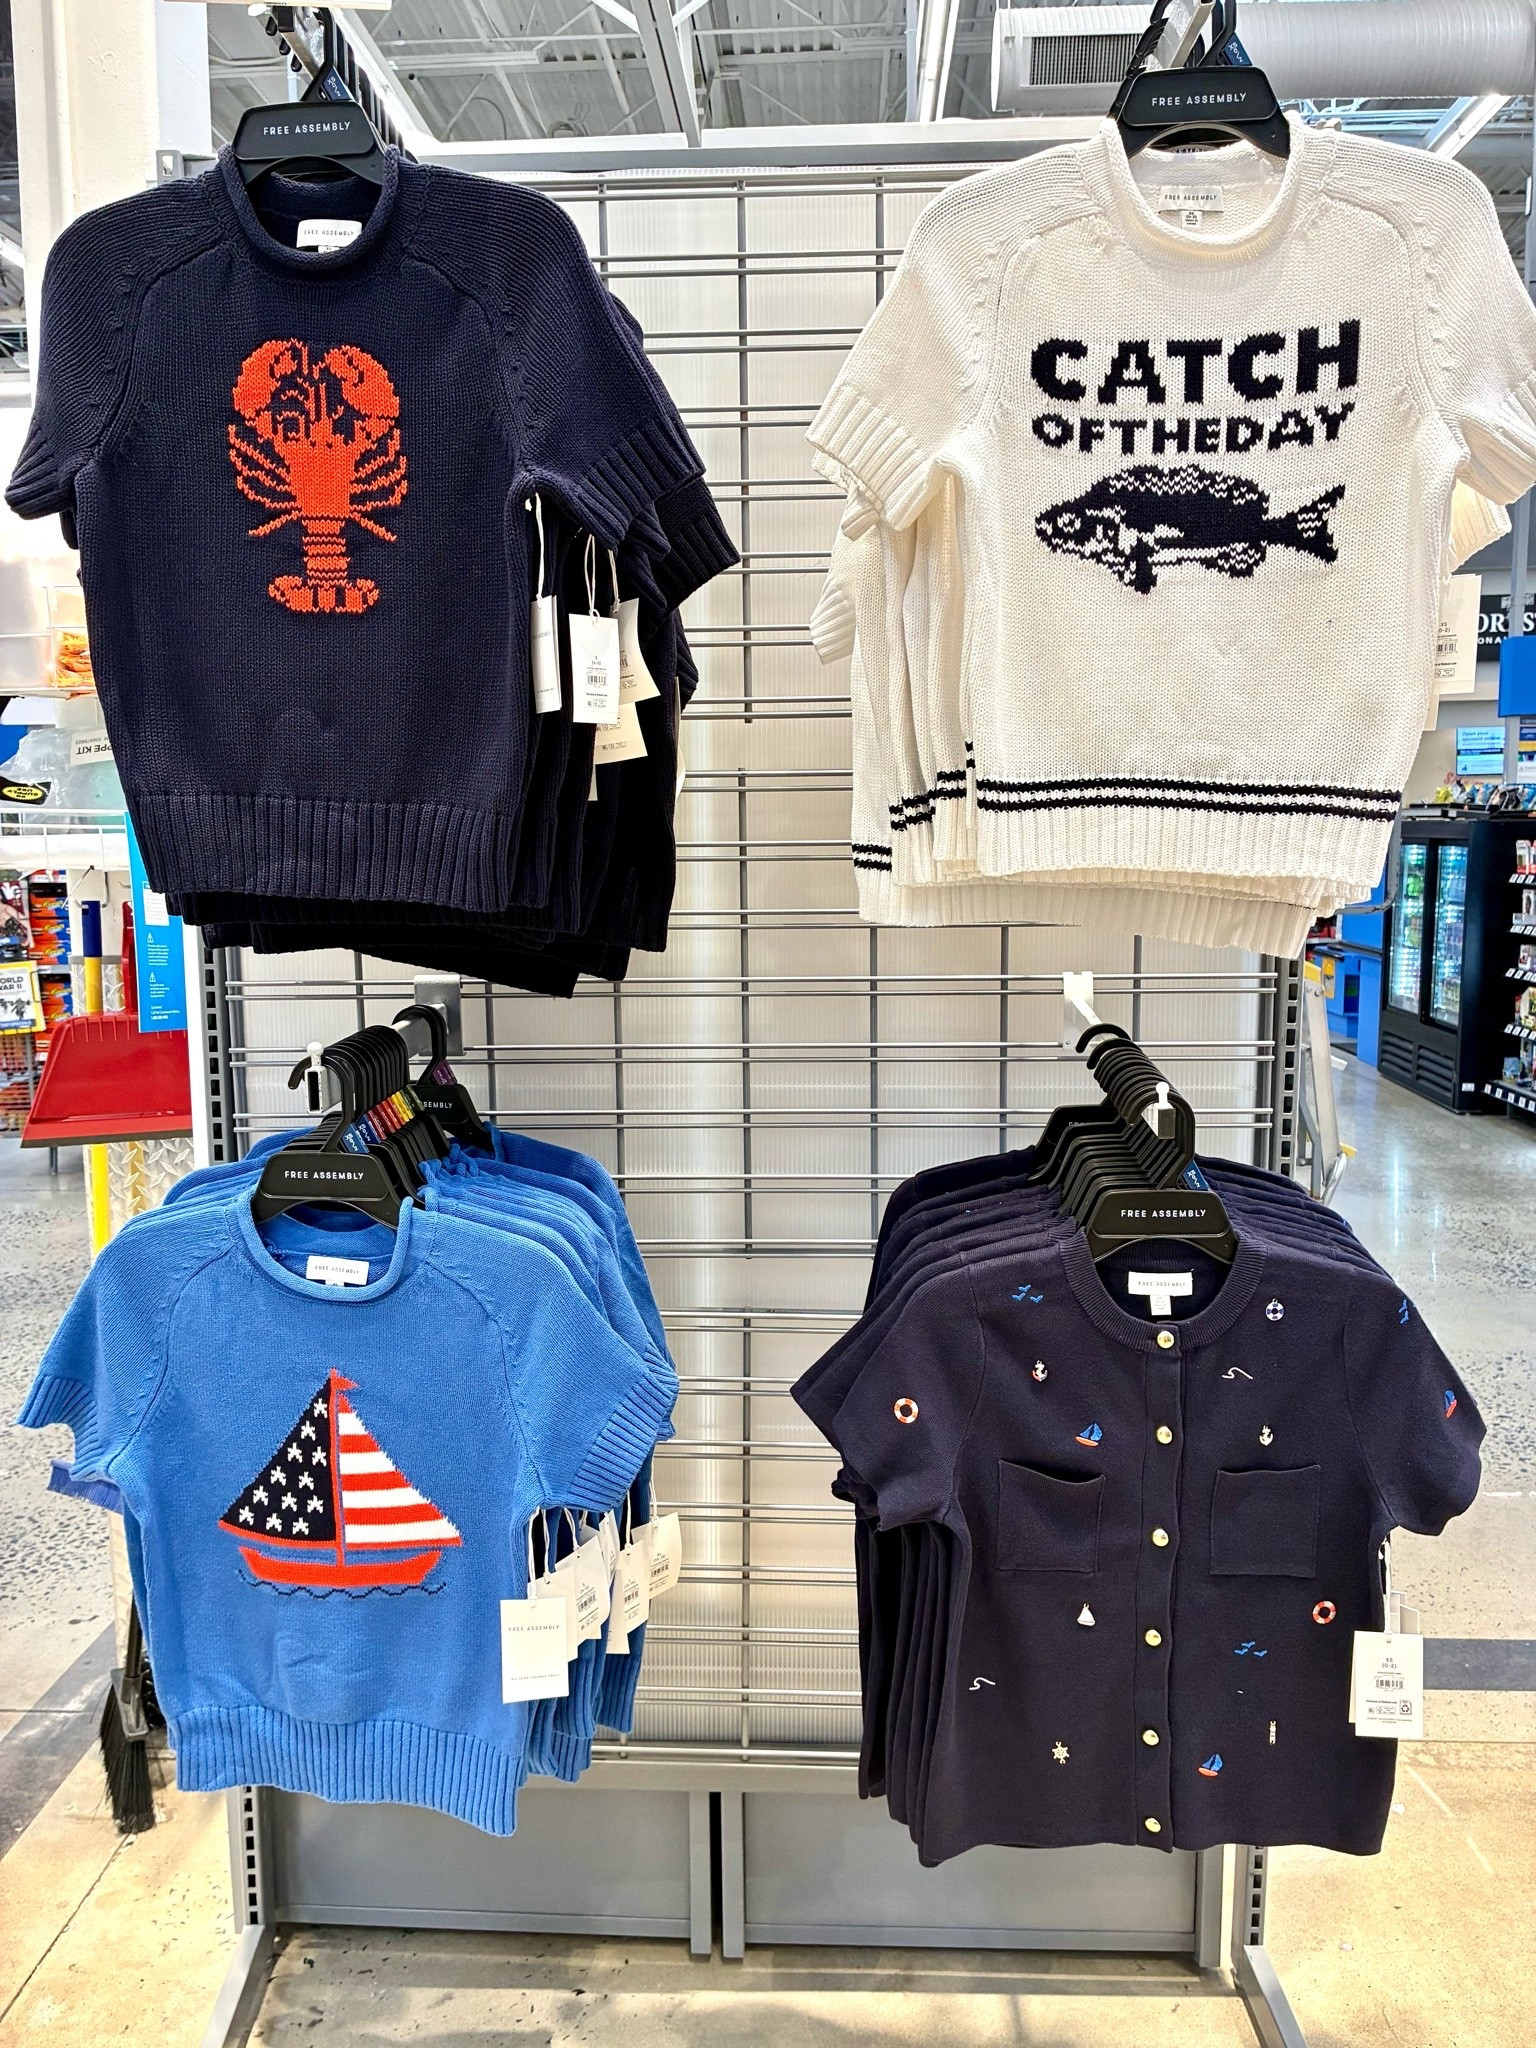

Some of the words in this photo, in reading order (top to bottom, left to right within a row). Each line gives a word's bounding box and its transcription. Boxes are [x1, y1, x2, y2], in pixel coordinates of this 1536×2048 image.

[1151, 96, 1180, 107] FREE
[1186, 92, 1247, 105] ASSEMBLY
[263, 126, 290, 136] FREE
[294, 121, 351, 134] ASSEMBLY
[1031, 319, 1360, 406] CATCH
[76, 746, 92, 755] KIT
[284, 1170, 309, 1179] FREE
[313, 1171, 364, 1180] ASSEMBLY
[1120, 1209, 1147, 1218] FREE
[1151, 1209, 1206, 1218] ASSEMBLY
